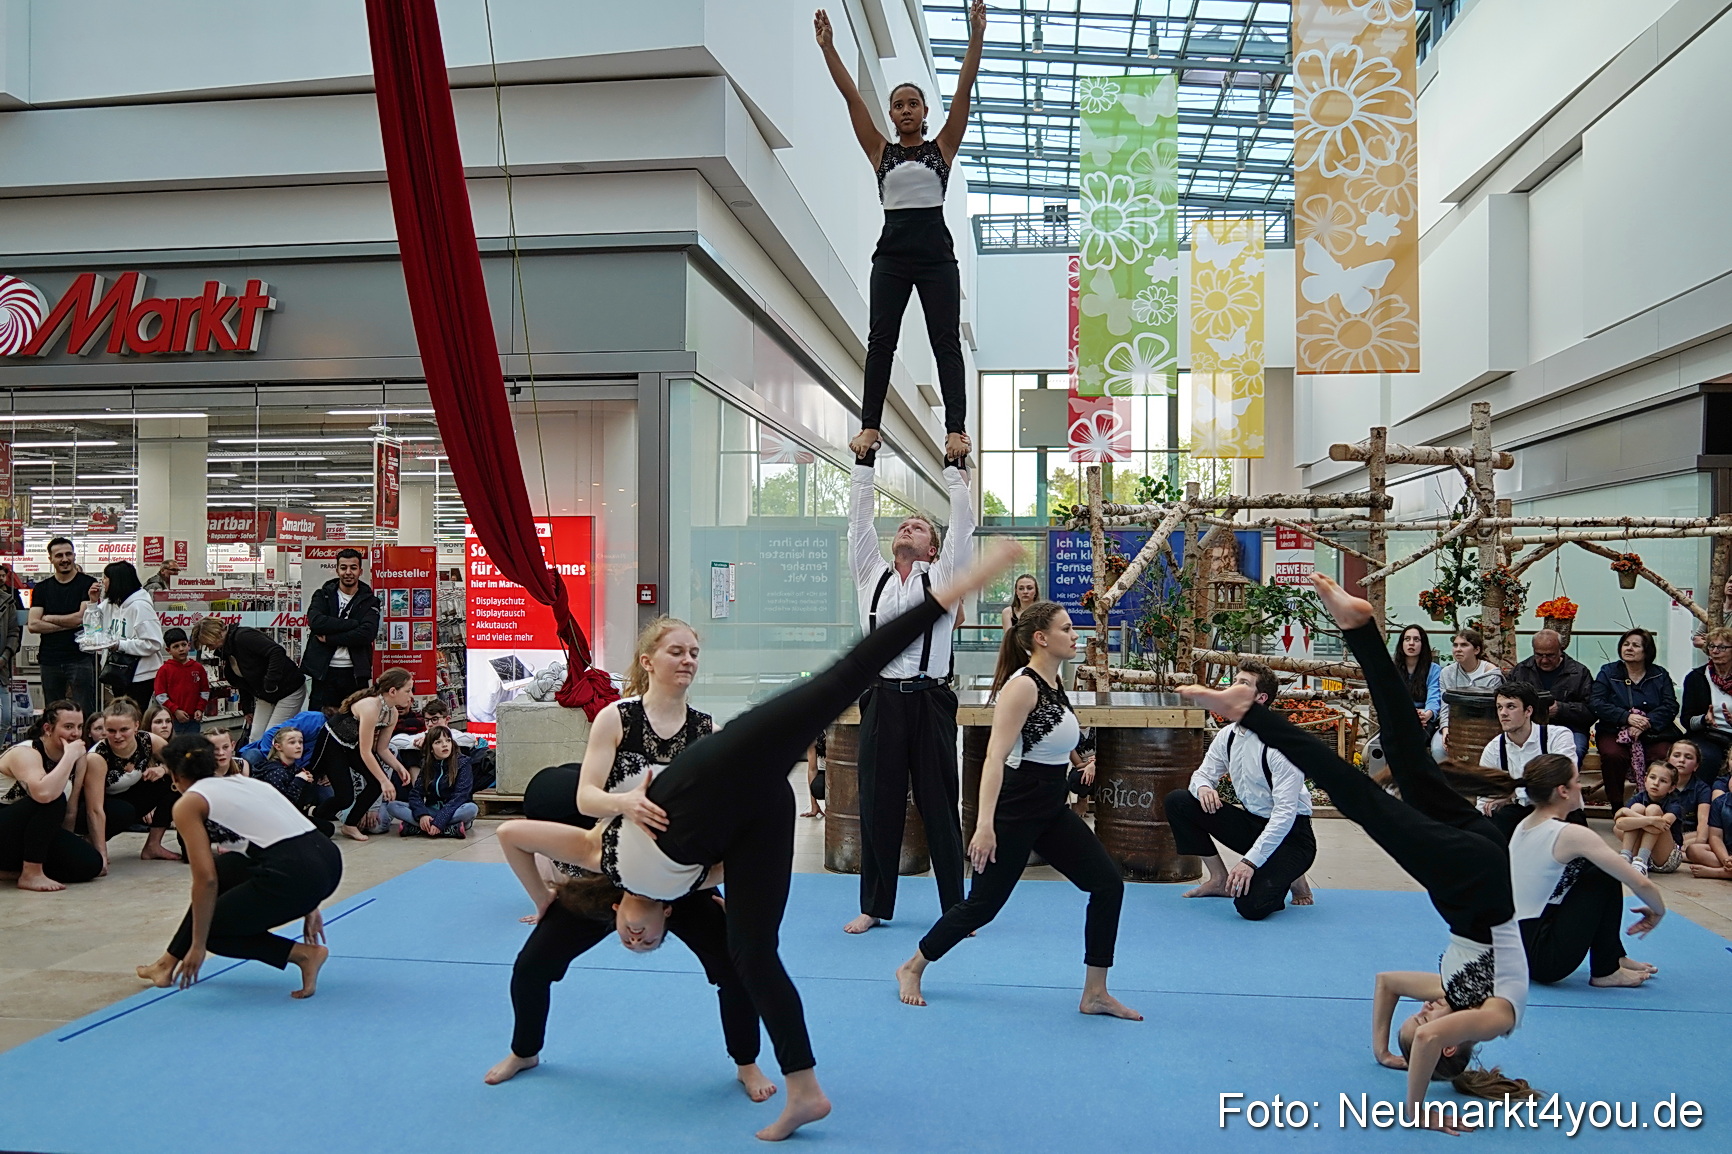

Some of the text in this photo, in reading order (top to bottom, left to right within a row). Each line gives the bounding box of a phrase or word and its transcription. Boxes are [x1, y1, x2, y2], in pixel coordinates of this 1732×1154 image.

[22, 272, 275, 356] Markt
[207, 516, 253, 531] artbar
[282, 517, 316, 533] Smartbar
[98, 543, 136, 553] GROßGER
[1056, 537, 1073, 548] Ich
[1056, 551, 1078, 560] den
[375, 568, 430, 579] Vorbesteller
[471, 561, 493, 576] für
[1276, 564, 1300, 575] REWE
[471, 579, 487, 589] hier
[487, 579, 498, 589] im
[1056, 574, 1076, 585] der
[1276, 575, 1300, 584] CENTER
[475, 597, 526, 607] Displayschutz
[475, 608, 526, 619] Displaytausch
[475, 620, 518, 630] Akkutausch
[476, 633, 534, 641] und vieles mehr
